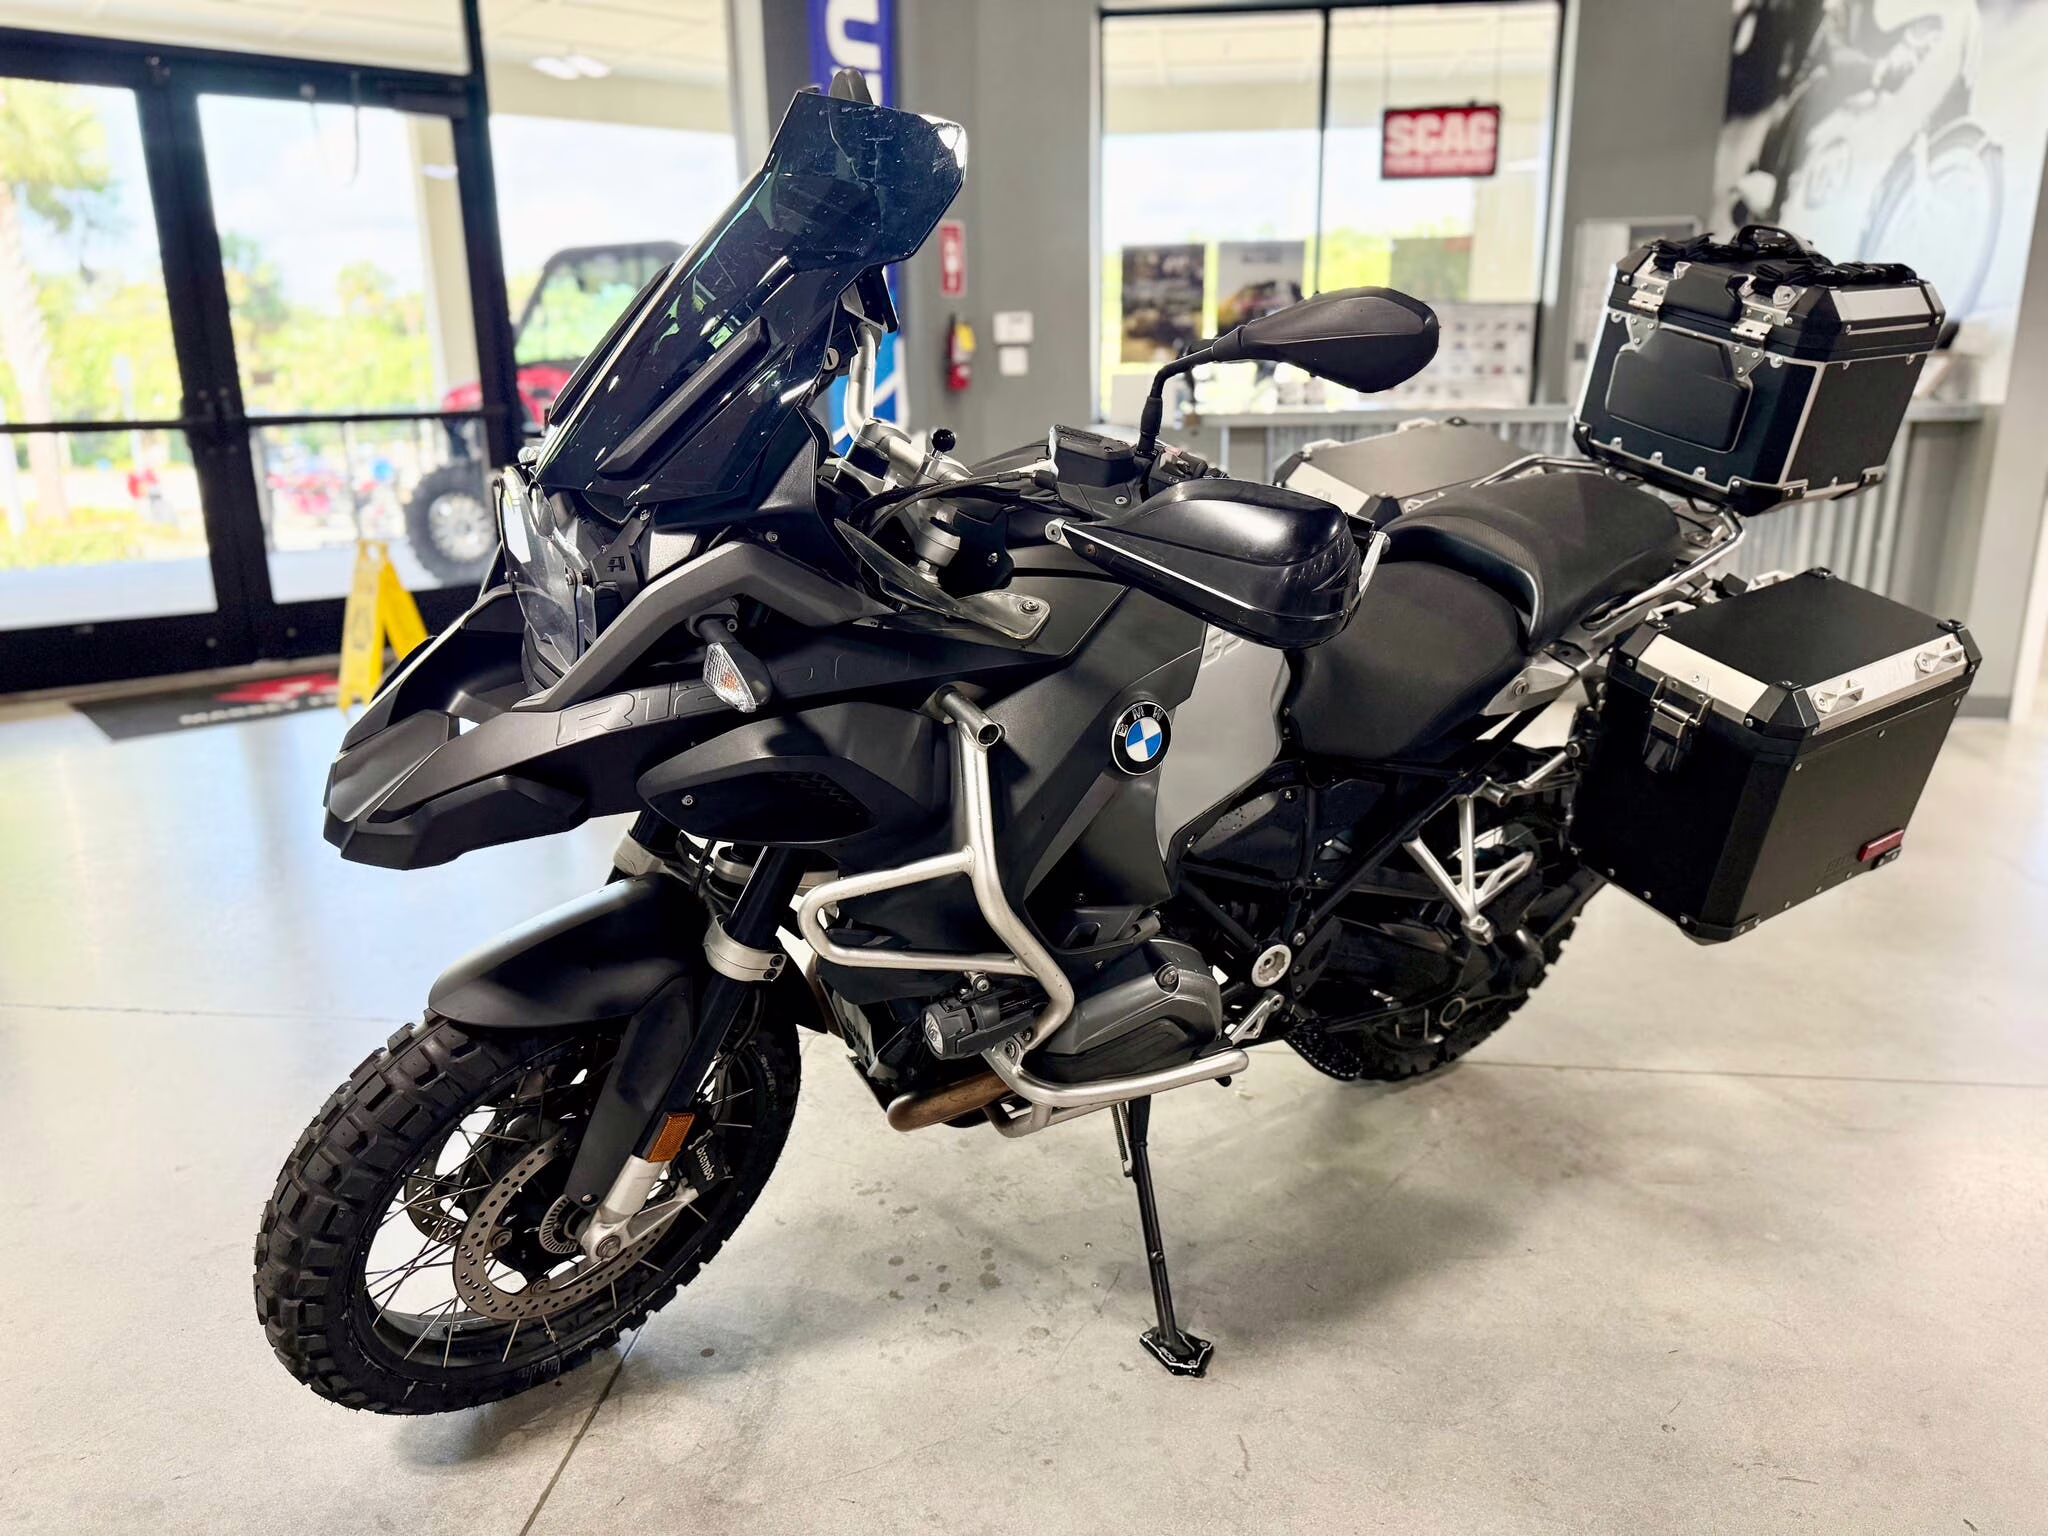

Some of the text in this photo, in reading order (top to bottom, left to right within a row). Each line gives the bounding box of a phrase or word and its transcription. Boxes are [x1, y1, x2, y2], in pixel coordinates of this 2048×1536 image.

[1386, 111, 1497, 155] SCAG
[1115, 706, 1163, 738] BMW
[696, 1143, 715, 1182] brembo
